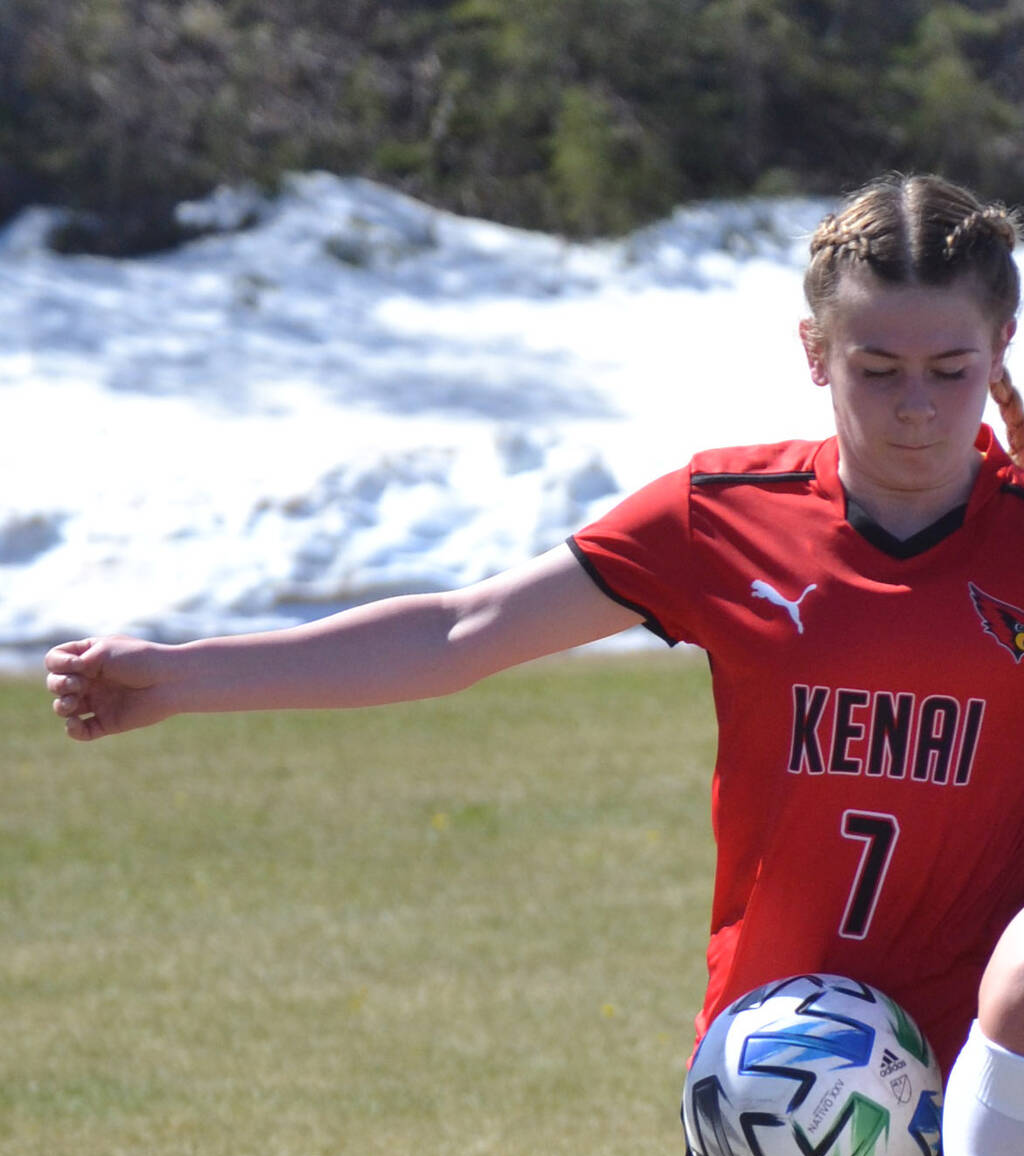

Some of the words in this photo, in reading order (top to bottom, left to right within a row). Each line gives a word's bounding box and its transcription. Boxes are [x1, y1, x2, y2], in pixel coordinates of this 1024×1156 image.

[787, 684, 986, 786] KENAI
[838, 809, 901, 940] 7
[808, 1098, 833, 1133] NATIVO
[831, 1078, 845, 1099] XXV
[880, 1060, 906, 1077] adidas
